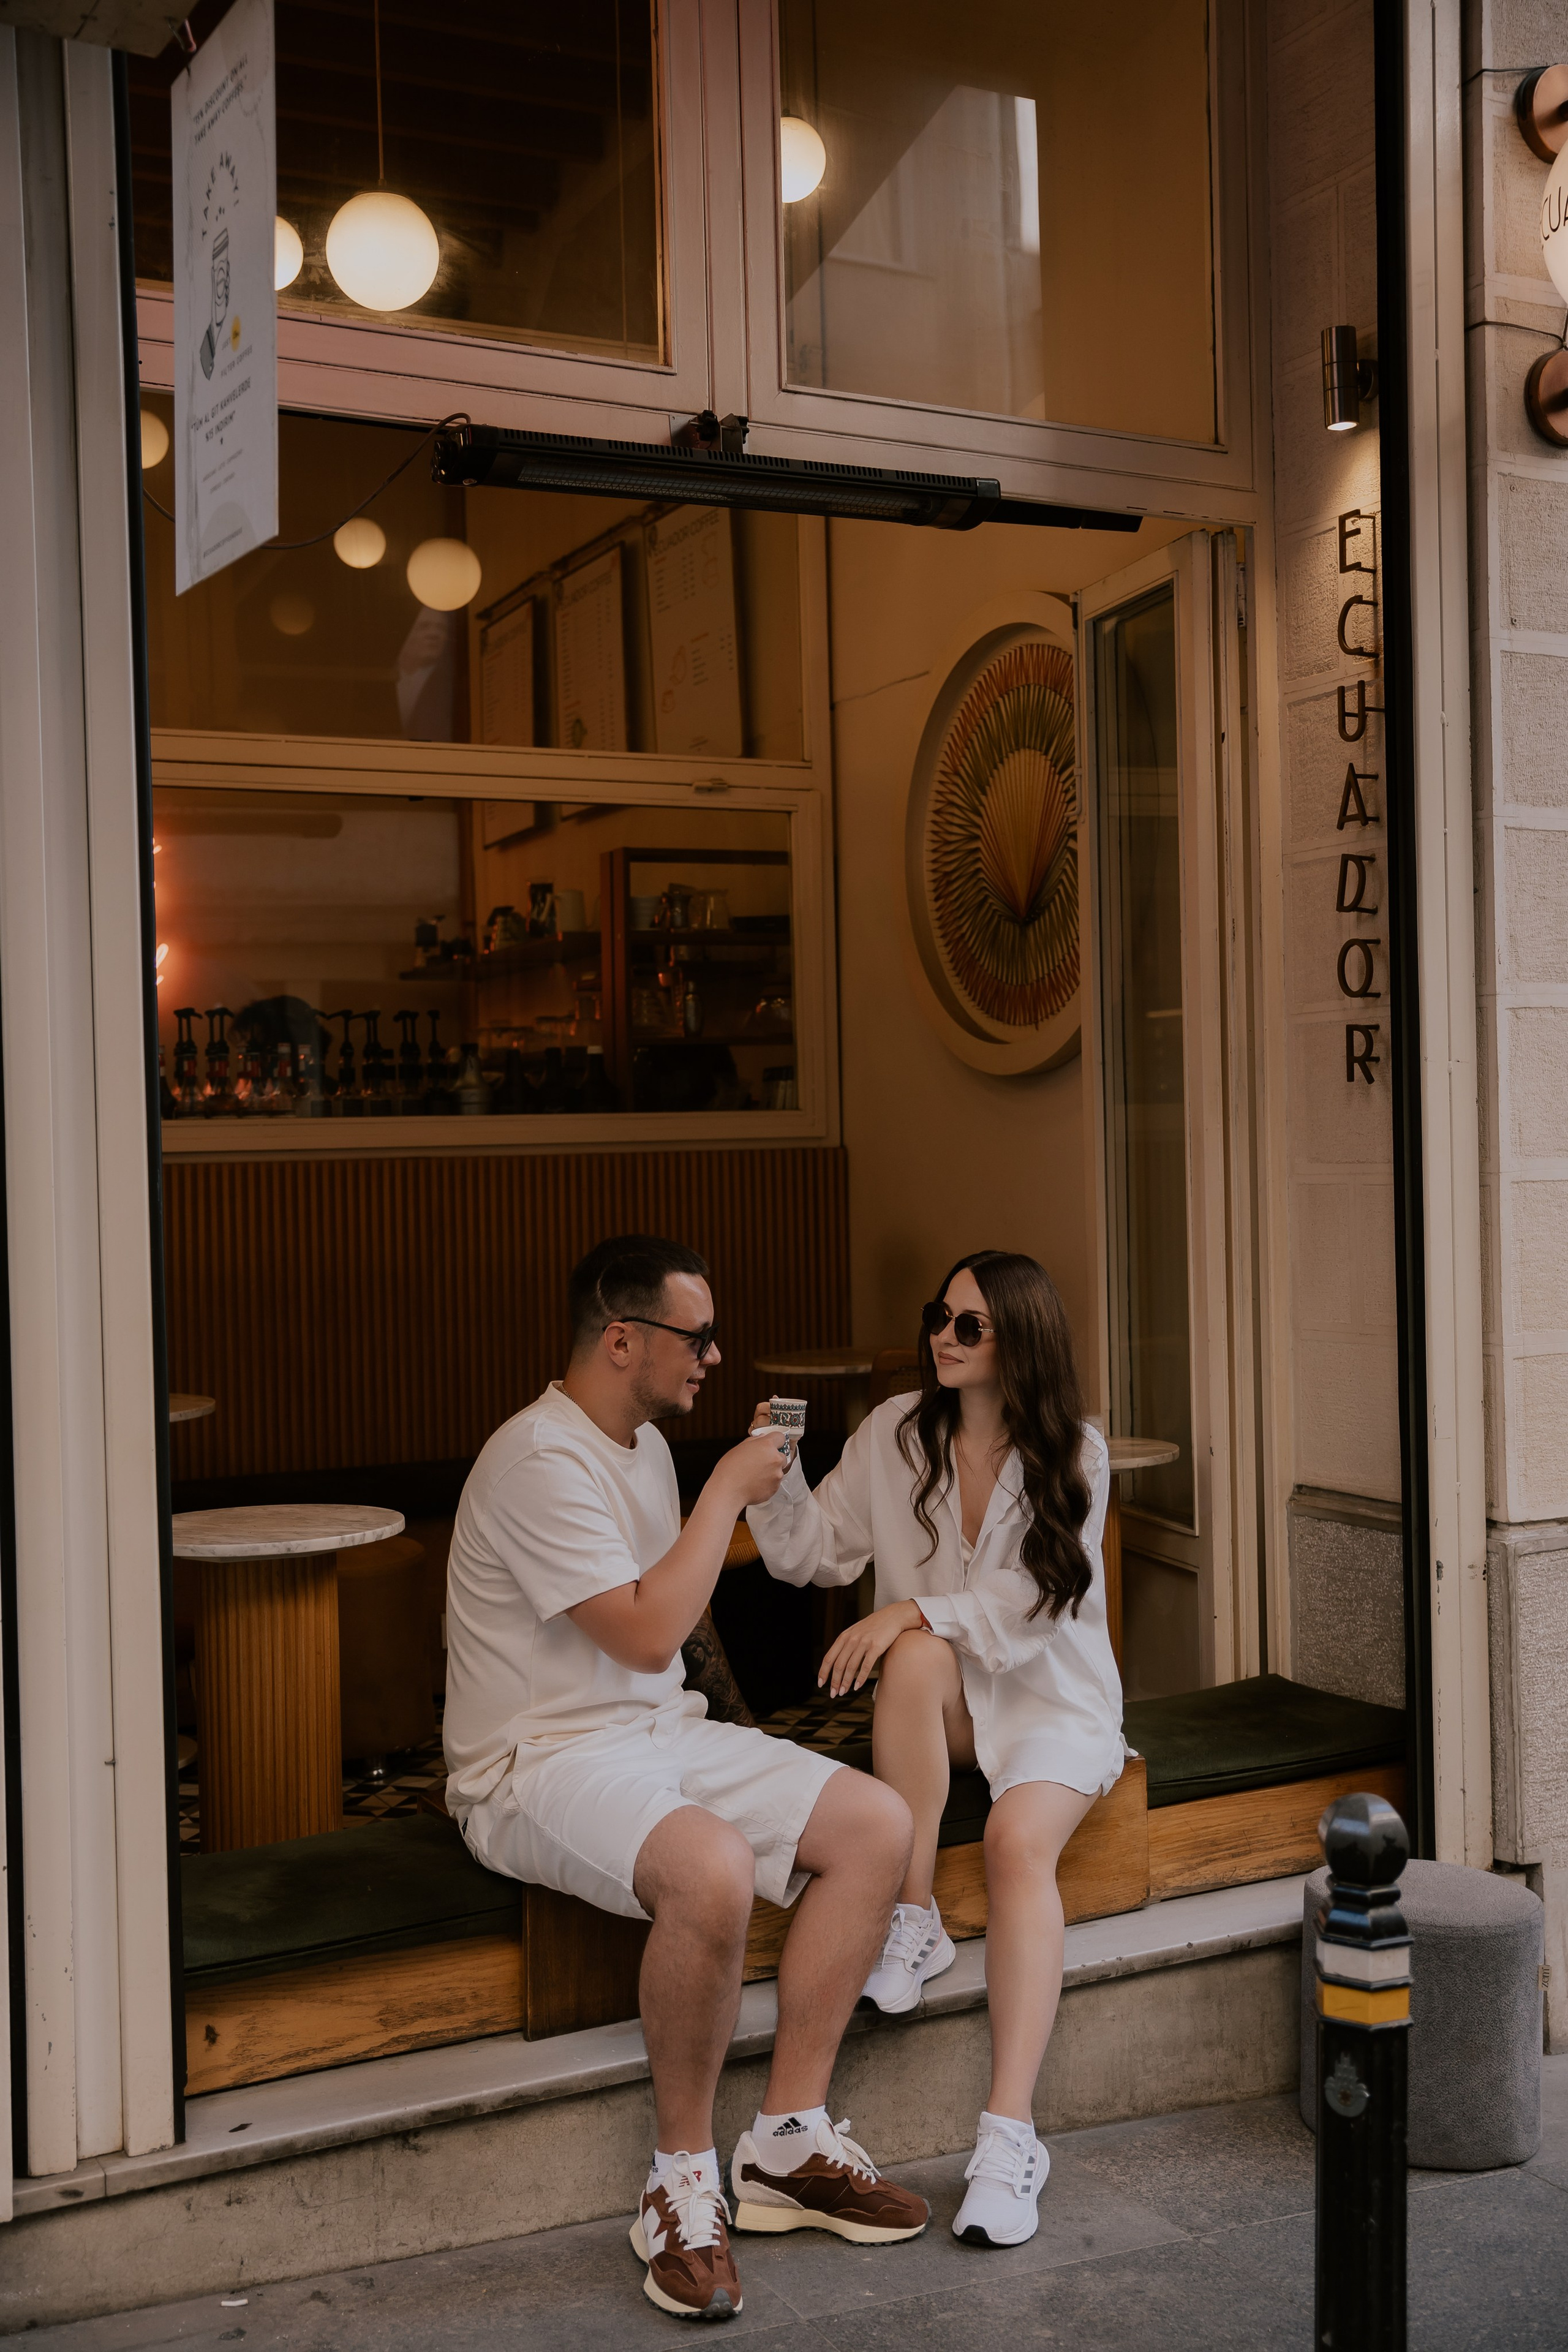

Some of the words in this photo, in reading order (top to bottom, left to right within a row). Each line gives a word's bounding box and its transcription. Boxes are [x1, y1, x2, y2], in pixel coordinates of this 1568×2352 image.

[194, 124, 206, 146] TAKE
[208, 107, 221, 132] AWAY
[201, 165, 216, 241] TAKE
[219, 151, 239, 207] AWAY!
[221, 360, 235, 379] FILTER
[236, 344, 252, 364] COFFEE
[1336, 509, 1374, 1085] ECUADOR
[772, 2125, 809, 2138] adidas
